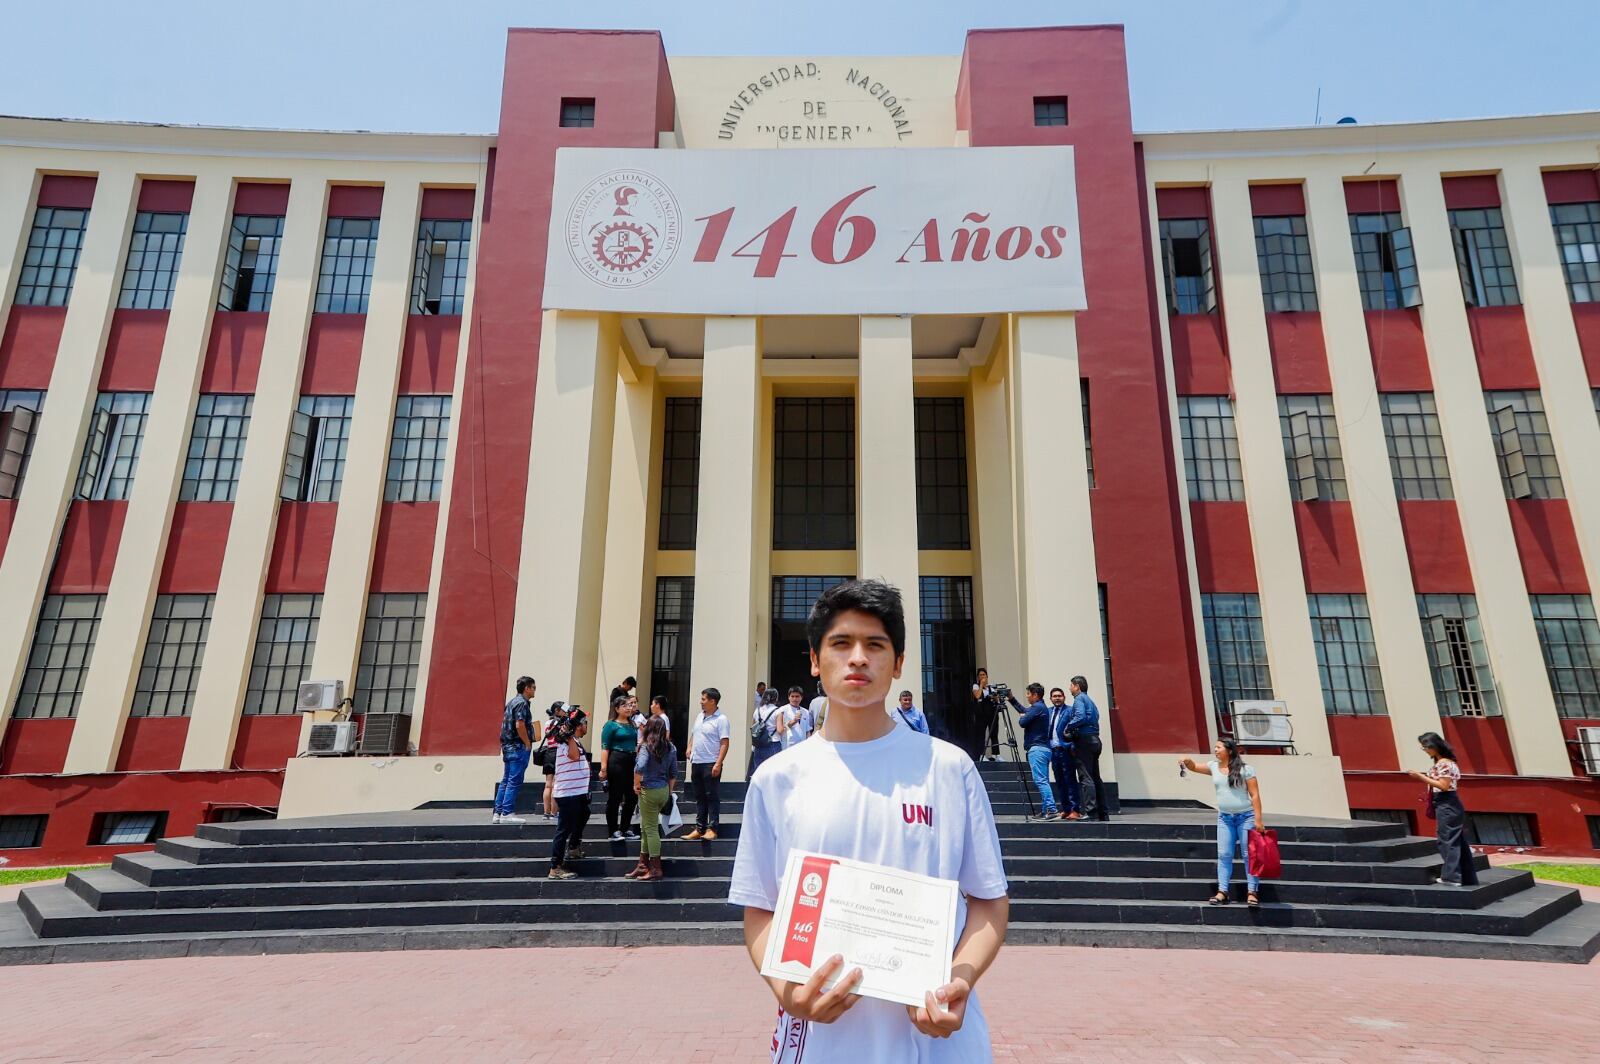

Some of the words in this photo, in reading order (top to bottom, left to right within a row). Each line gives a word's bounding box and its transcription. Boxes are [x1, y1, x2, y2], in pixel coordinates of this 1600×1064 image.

[803, 101, 827, 116] DE
[845, 67, 913, 141] NACIONAL
[570, 187, 598, 248] UNIVERSIDAD
[599, 173, 655, 188] NACIONAL
[692, 185, 877, 278] 146
[895, 211, 1067, 264] Años
[581, 256, 600, 277] LIMA
[606, 275, 633, 284] 1876
[902, 803, 933, 827] UNI
[869, 882, 904, 897] DIPLOMA
[792, 933, 809, 943] Años
[793, 921, 815, 934] 146
